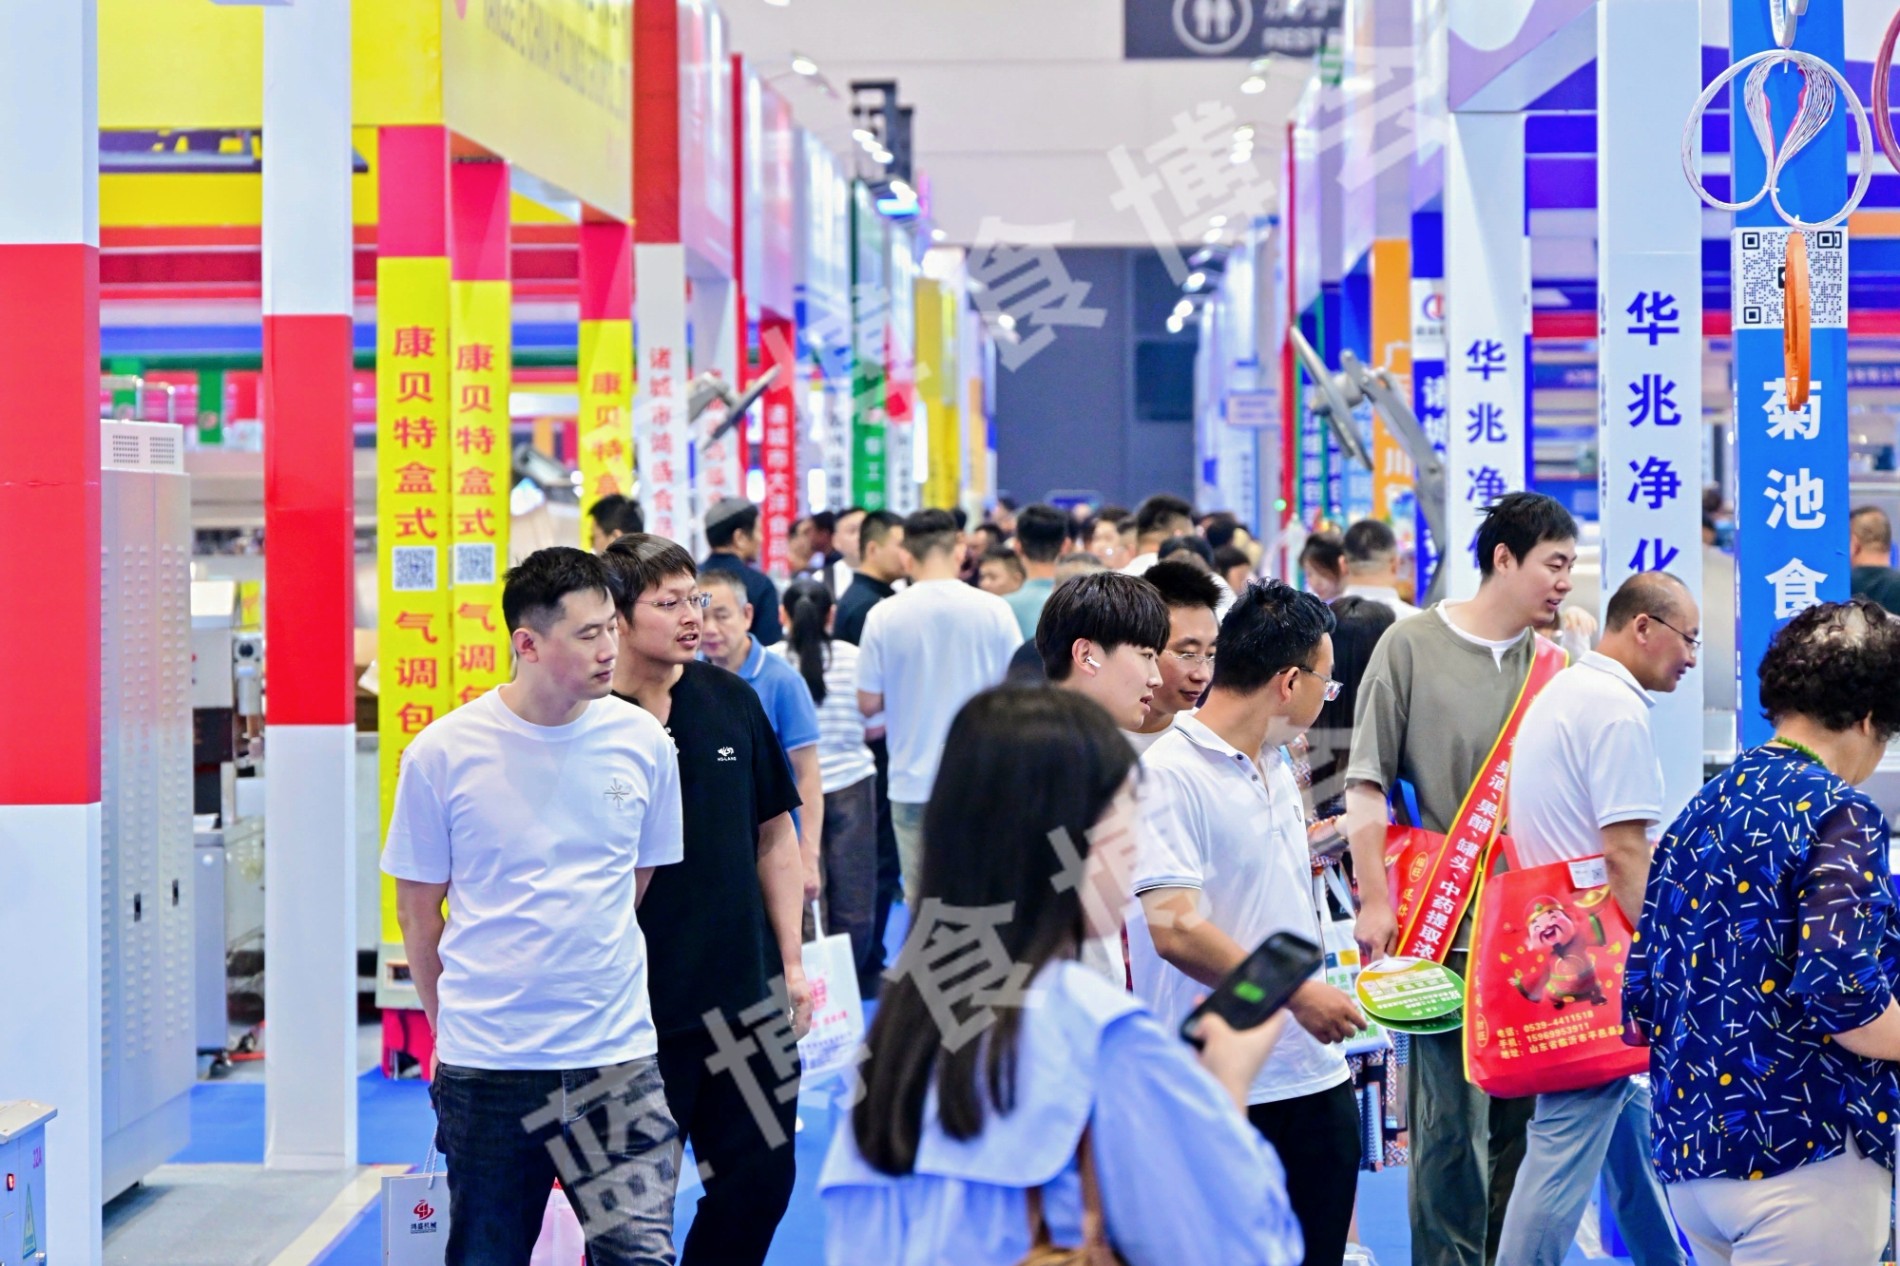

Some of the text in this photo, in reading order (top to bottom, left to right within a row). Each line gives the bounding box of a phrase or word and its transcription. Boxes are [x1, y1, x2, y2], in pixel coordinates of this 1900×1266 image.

[393, 326, 437, 539] 康贝特盒式
[456, 343, 496, 537] 康贝特盒式
[1466, 340, 1507, 568] 华兆净
[1627, 291, 1681, 573] 华兆净化
[1762, 377, 1828, 620] 菊池食
[395, 611, 438, 777] 气调包
[1529, 1025, 1619, 1054] 山东省临沂市平邑县
